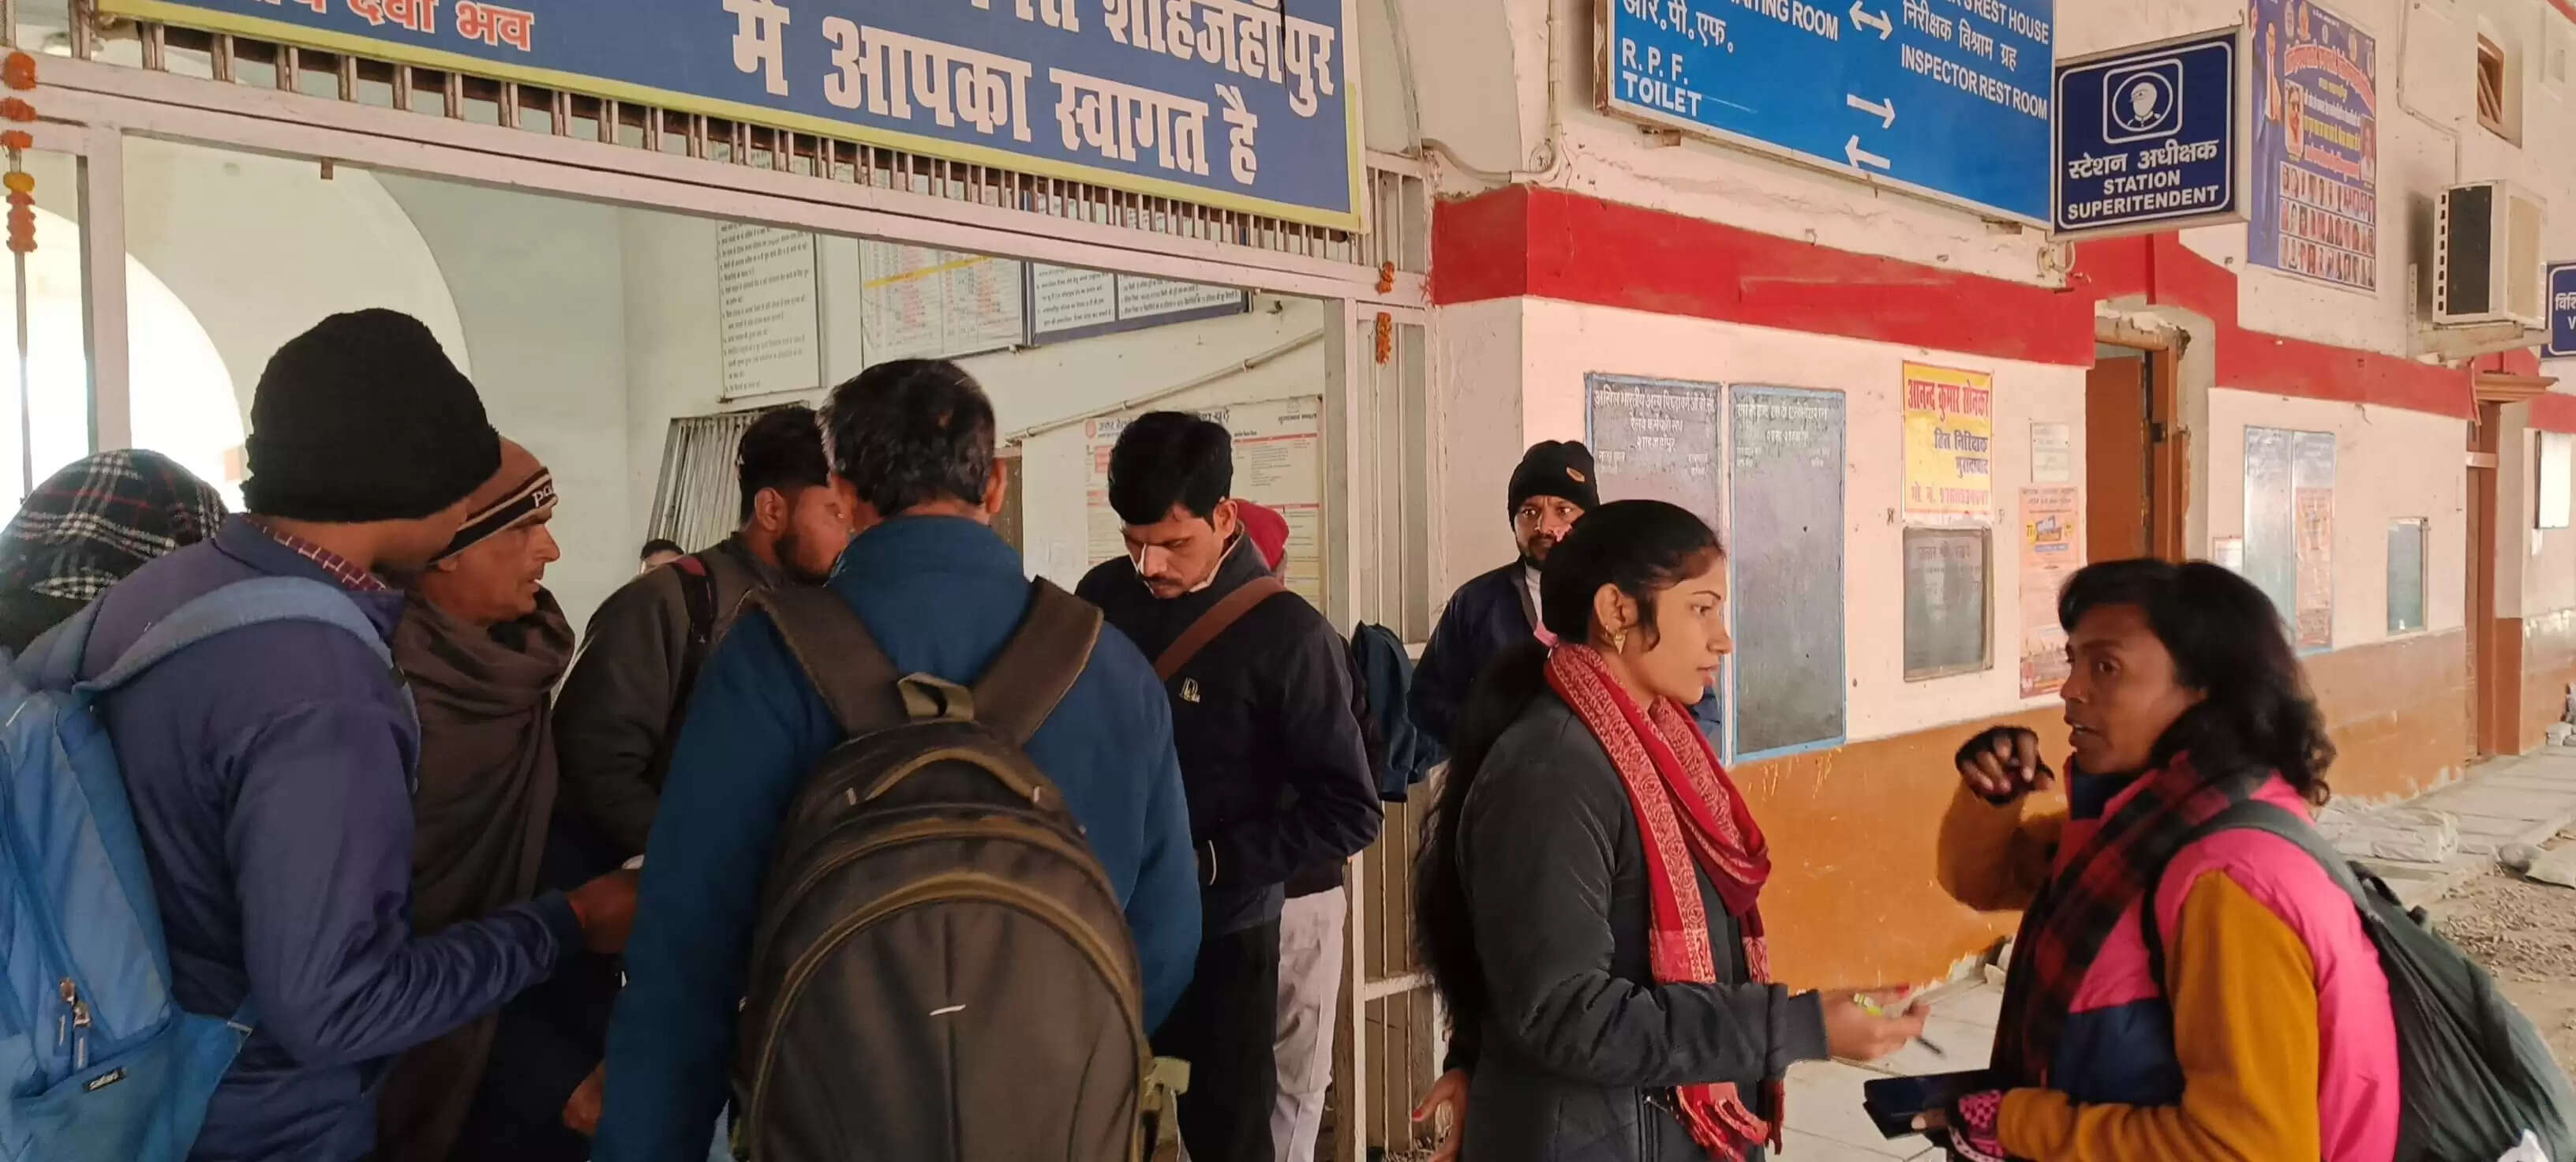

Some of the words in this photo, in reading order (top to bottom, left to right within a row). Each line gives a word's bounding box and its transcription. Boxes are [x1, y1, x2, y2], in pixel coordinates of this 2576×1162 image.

[455, 0, 534, 52] भव
[1792, 0, 1838, 42] ROOM
[1958, 18, 1994, 61] विश्राम
[1974, 0, 2007, 26] REST
[2008, 7, 2050, 45] HOUSE
[823, 15, 1032, 143] आपका
[1049, 66, 1209, 176] स्वागत
[1215, 83, 1258, 186] है
[1623, 70, 1702, 117] TOILET
[1901, 43, 1978, 96] INSPECTOR
[1979, 75, 2011, 107] REST
[2012, 88, 2048, 120] ROOM
[2068, 152, 2129, 180] स्टेशन
[2137, 138, 2219, 170] अधीक्षक
[2068, 186, 2219, 220] SUPERITENDENT
[2103, 170, 2181, 196] STATION
[1908, 378, 1936, 410] आनन्द
[1938, 383, 1960, 422] कुमार
